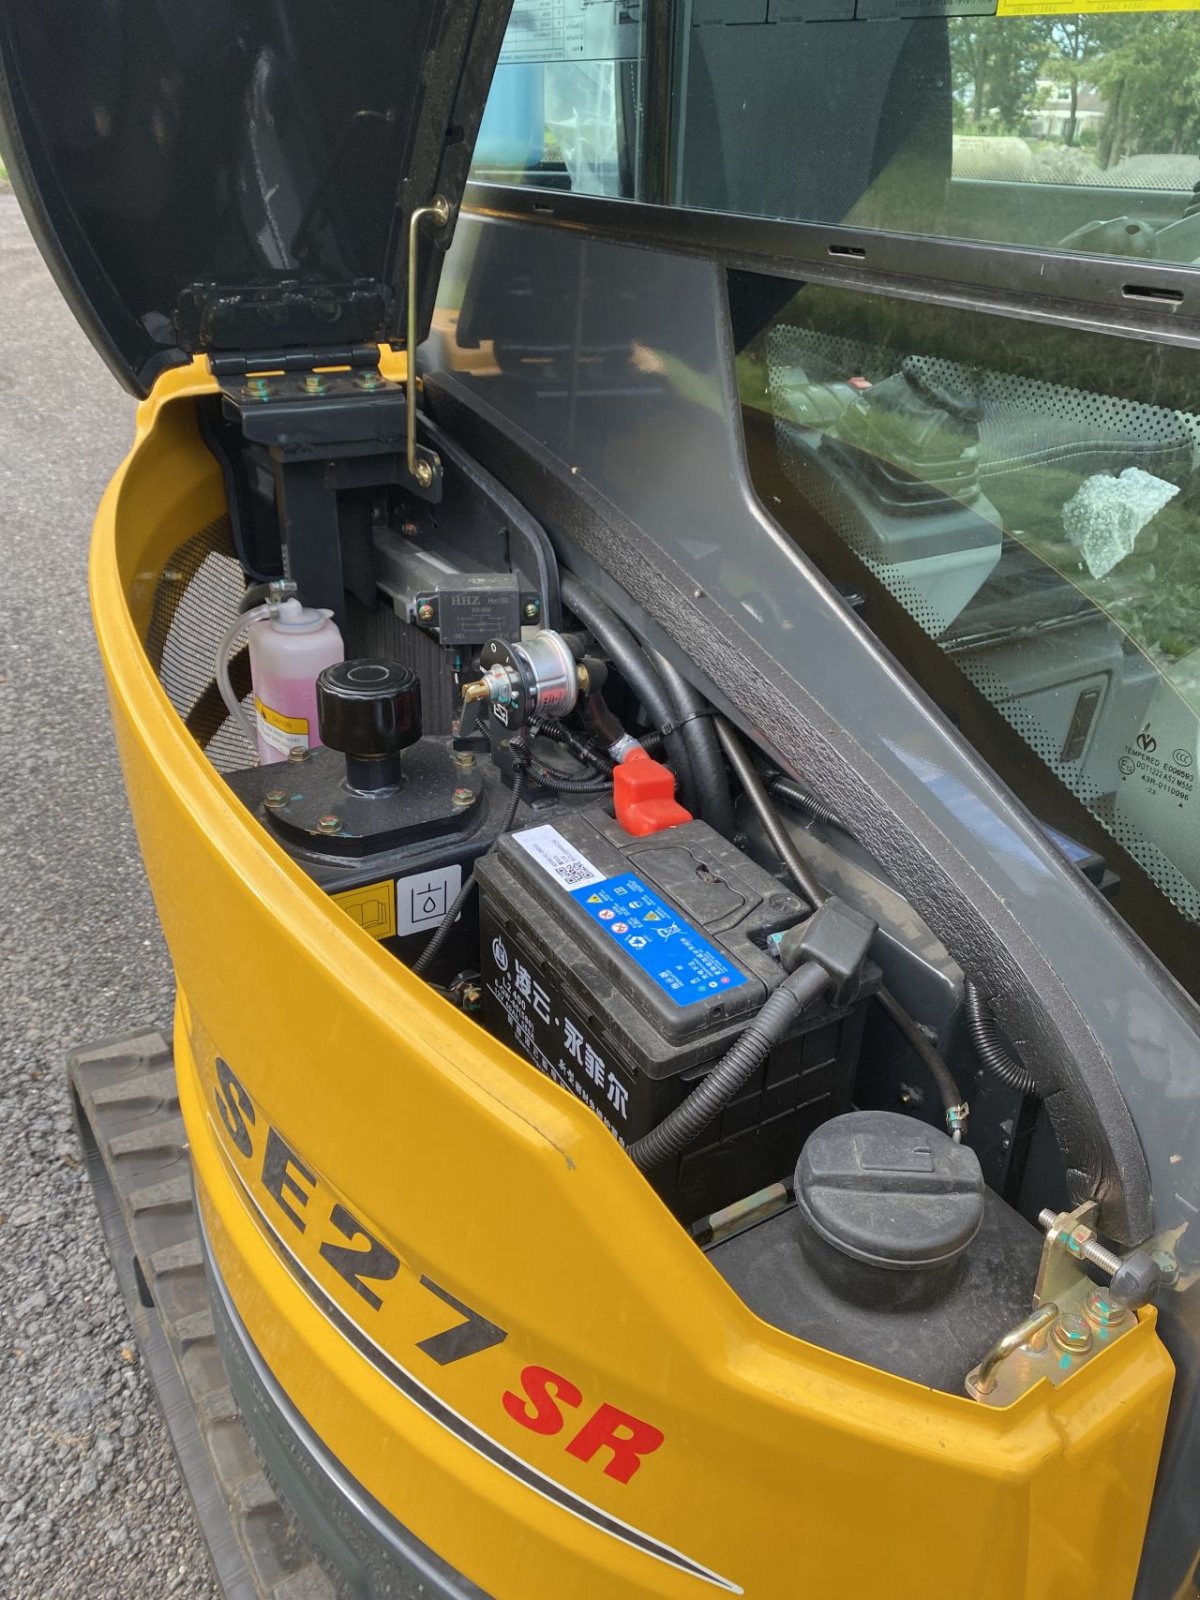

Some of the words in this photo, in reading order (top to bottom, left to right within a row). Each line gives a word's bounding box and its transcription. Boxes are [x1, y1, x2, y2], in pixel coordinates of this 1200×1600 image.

[451, 595, 481, 606] HHZ
[1125, 745, 1160, 766] TEMPERED
[213, 1056, 509, 1367] SE27
[501, 1364, 666, 1485] SR
